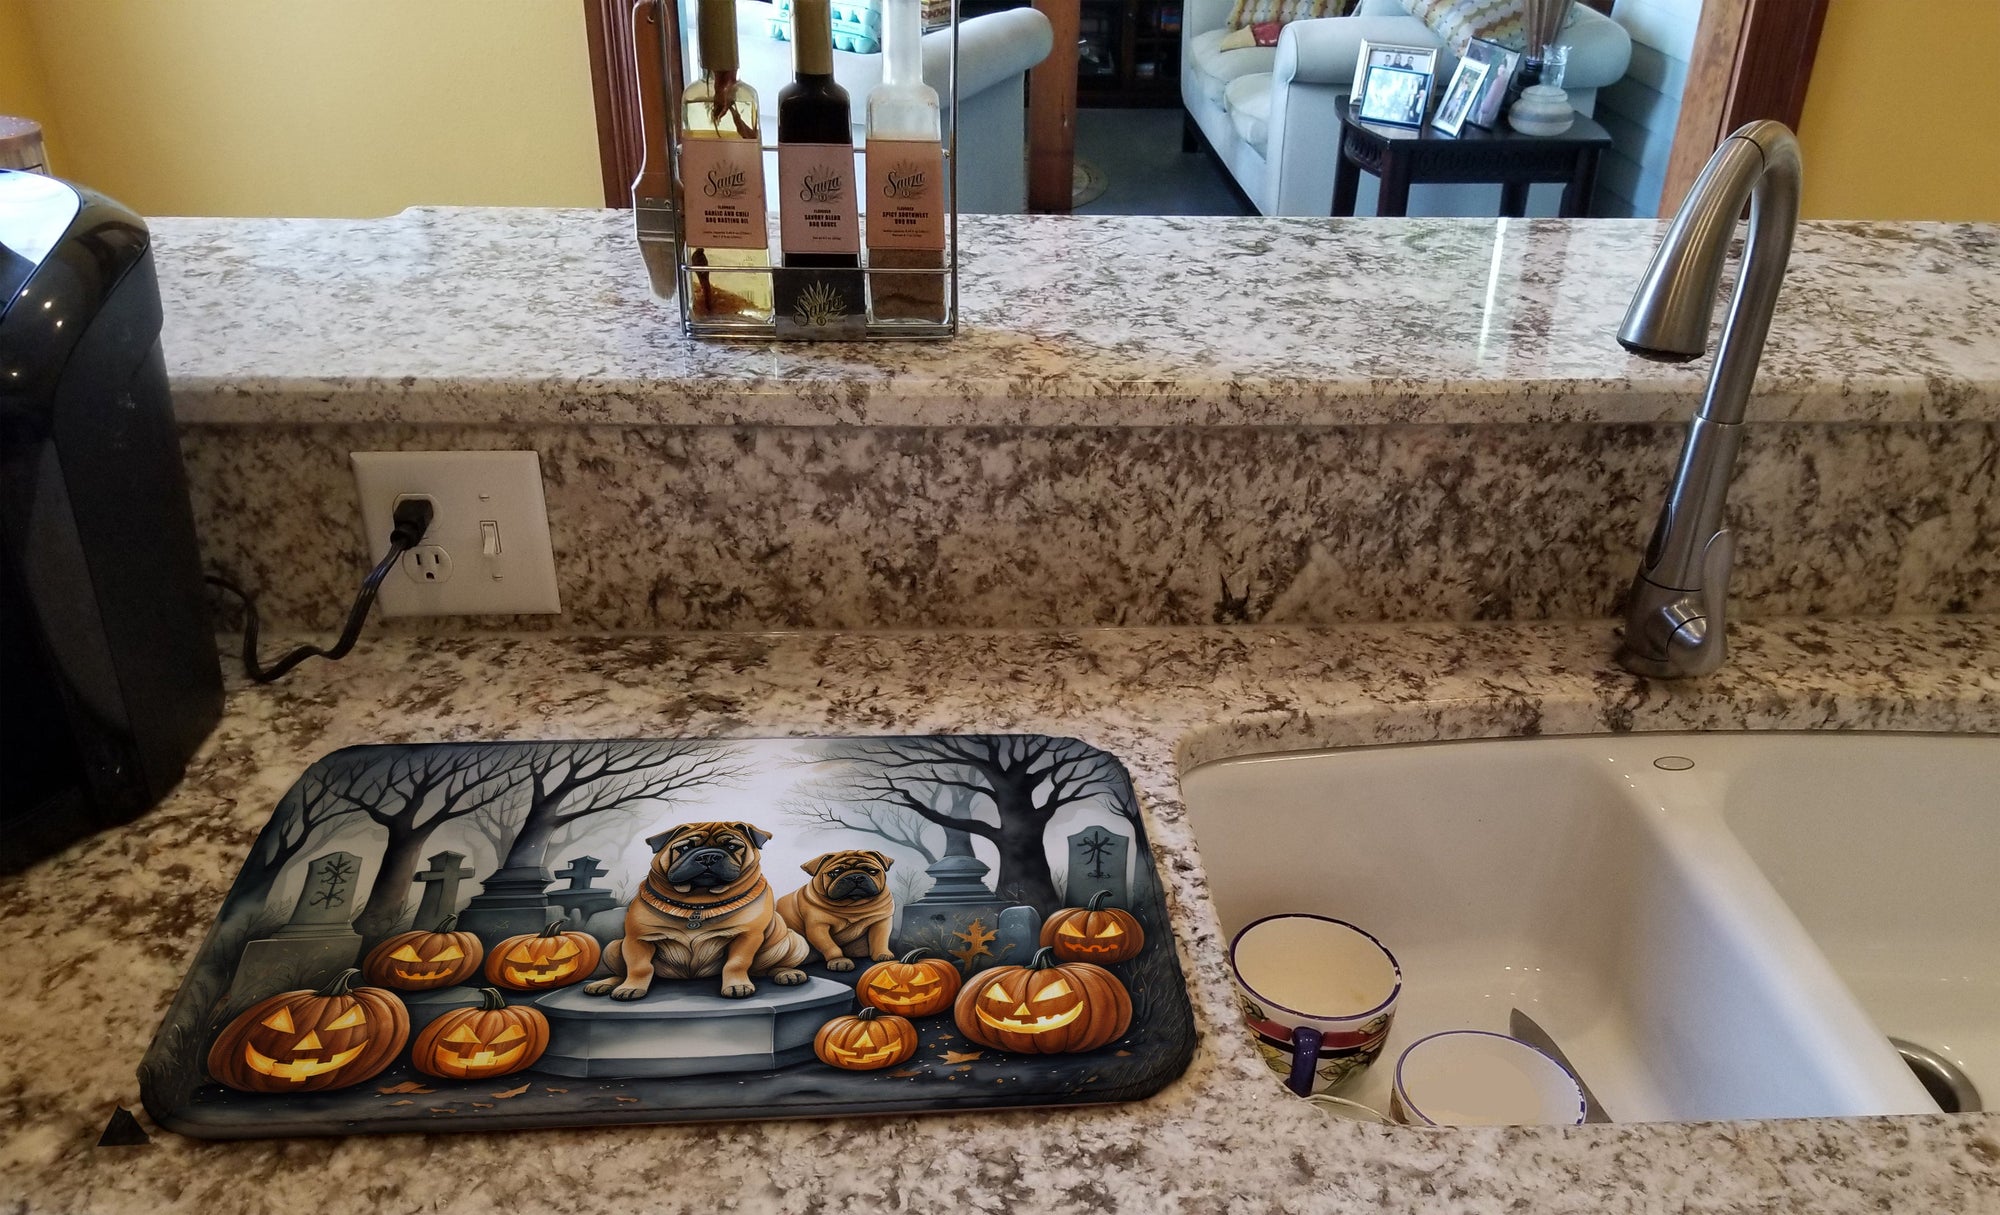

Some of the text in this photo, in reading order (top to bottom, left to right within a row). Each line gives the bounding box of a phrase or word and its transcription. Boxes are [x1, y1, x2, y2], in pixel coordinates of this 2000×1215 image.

[703, 170, 745, 197] Sauza
[800, 175, 841, 202] Sauza
[884, 171, 924, 198] Sauza
